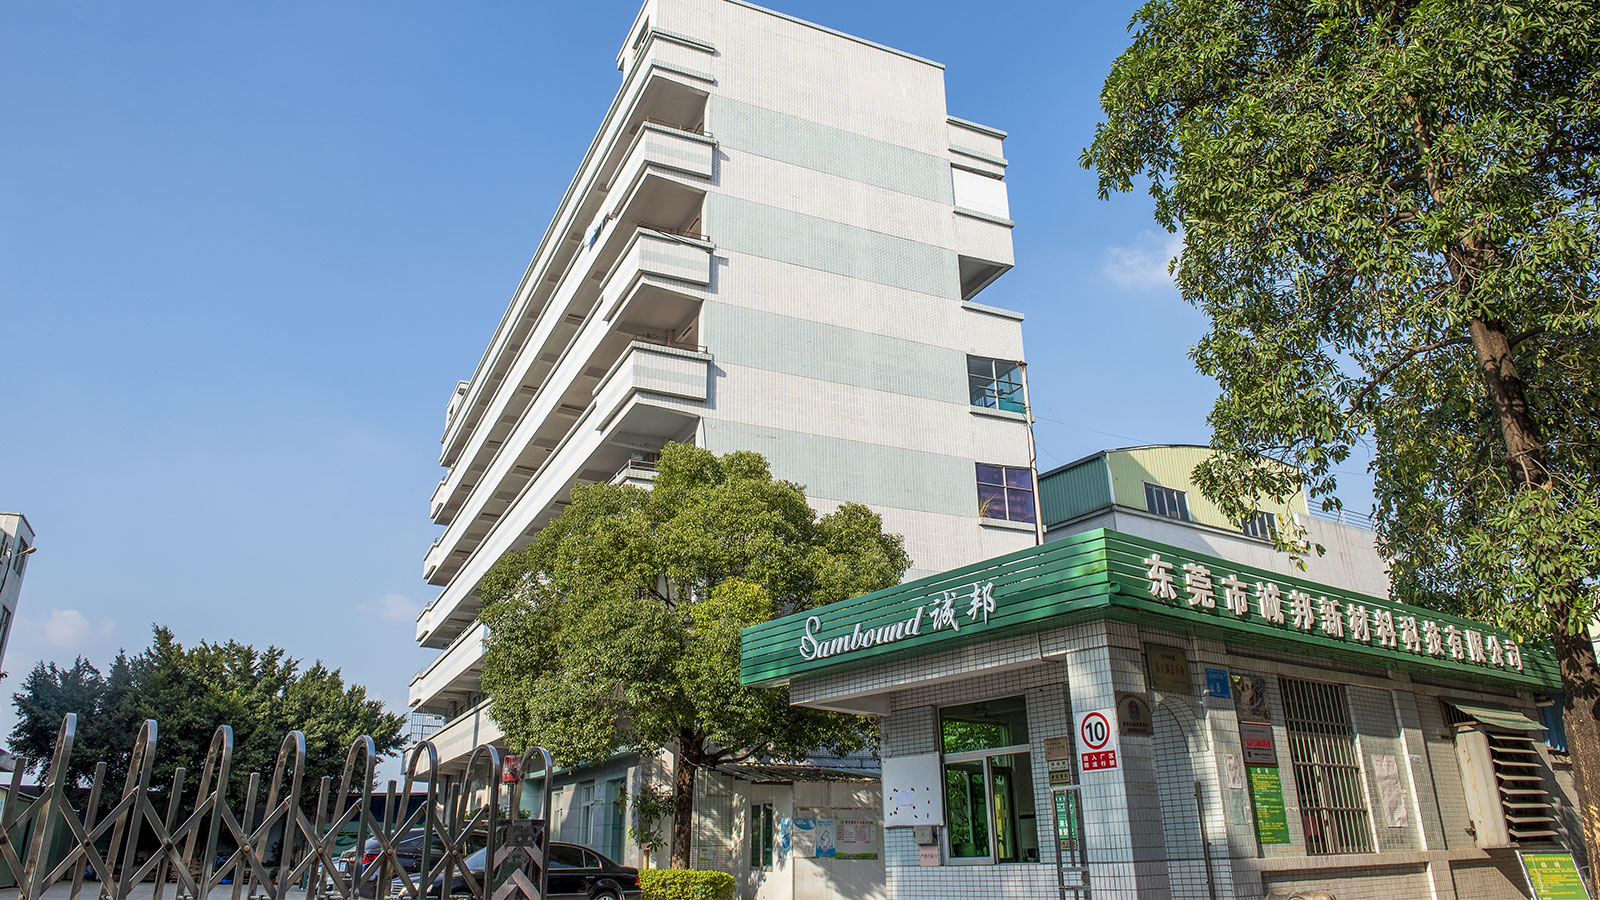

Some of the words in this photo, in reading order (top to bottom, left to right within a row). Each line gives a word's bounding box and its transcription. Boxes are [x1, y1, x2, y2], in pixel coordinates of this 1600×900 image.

[798, 606, 925, 662] Sambound
[929, 582, 997, 632] 诚邦
[1144, 553, 1524, 671] 东莞市诚邦新材料科技有限公司
[1085, 720, 1106, 743] 10
